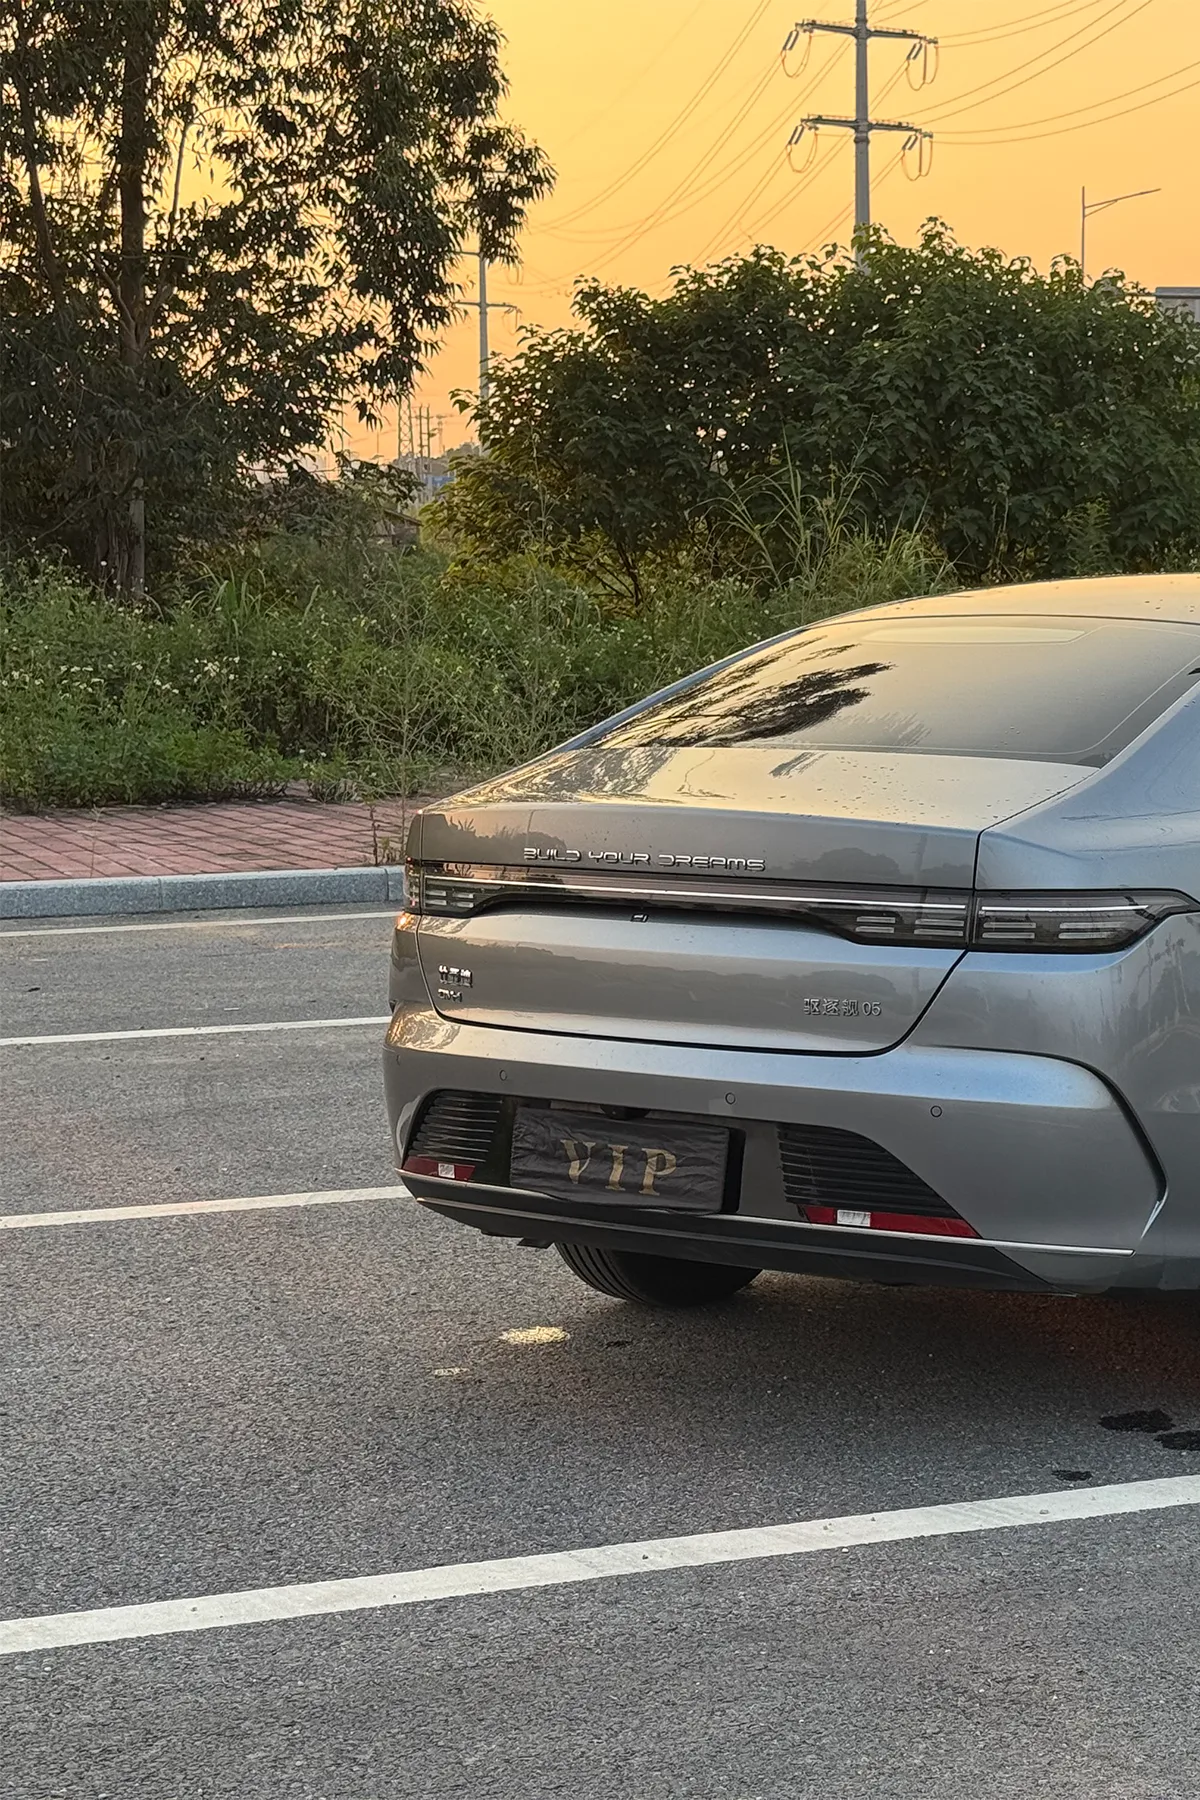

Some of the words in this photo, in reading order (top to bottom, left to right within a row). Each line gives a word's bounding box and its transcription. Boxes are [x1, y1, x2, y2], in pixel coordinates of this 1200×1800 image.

[523, 847, 581, 862] BUILD
[588, 850, 650, 866] YOUR
[658, 854, 766, 872] DREAMS
[803, 998, 860, 1016] 驱逐舰
[862, 1001, 882, 1016] 05
[560, 1139, 678, 1196] VIP
